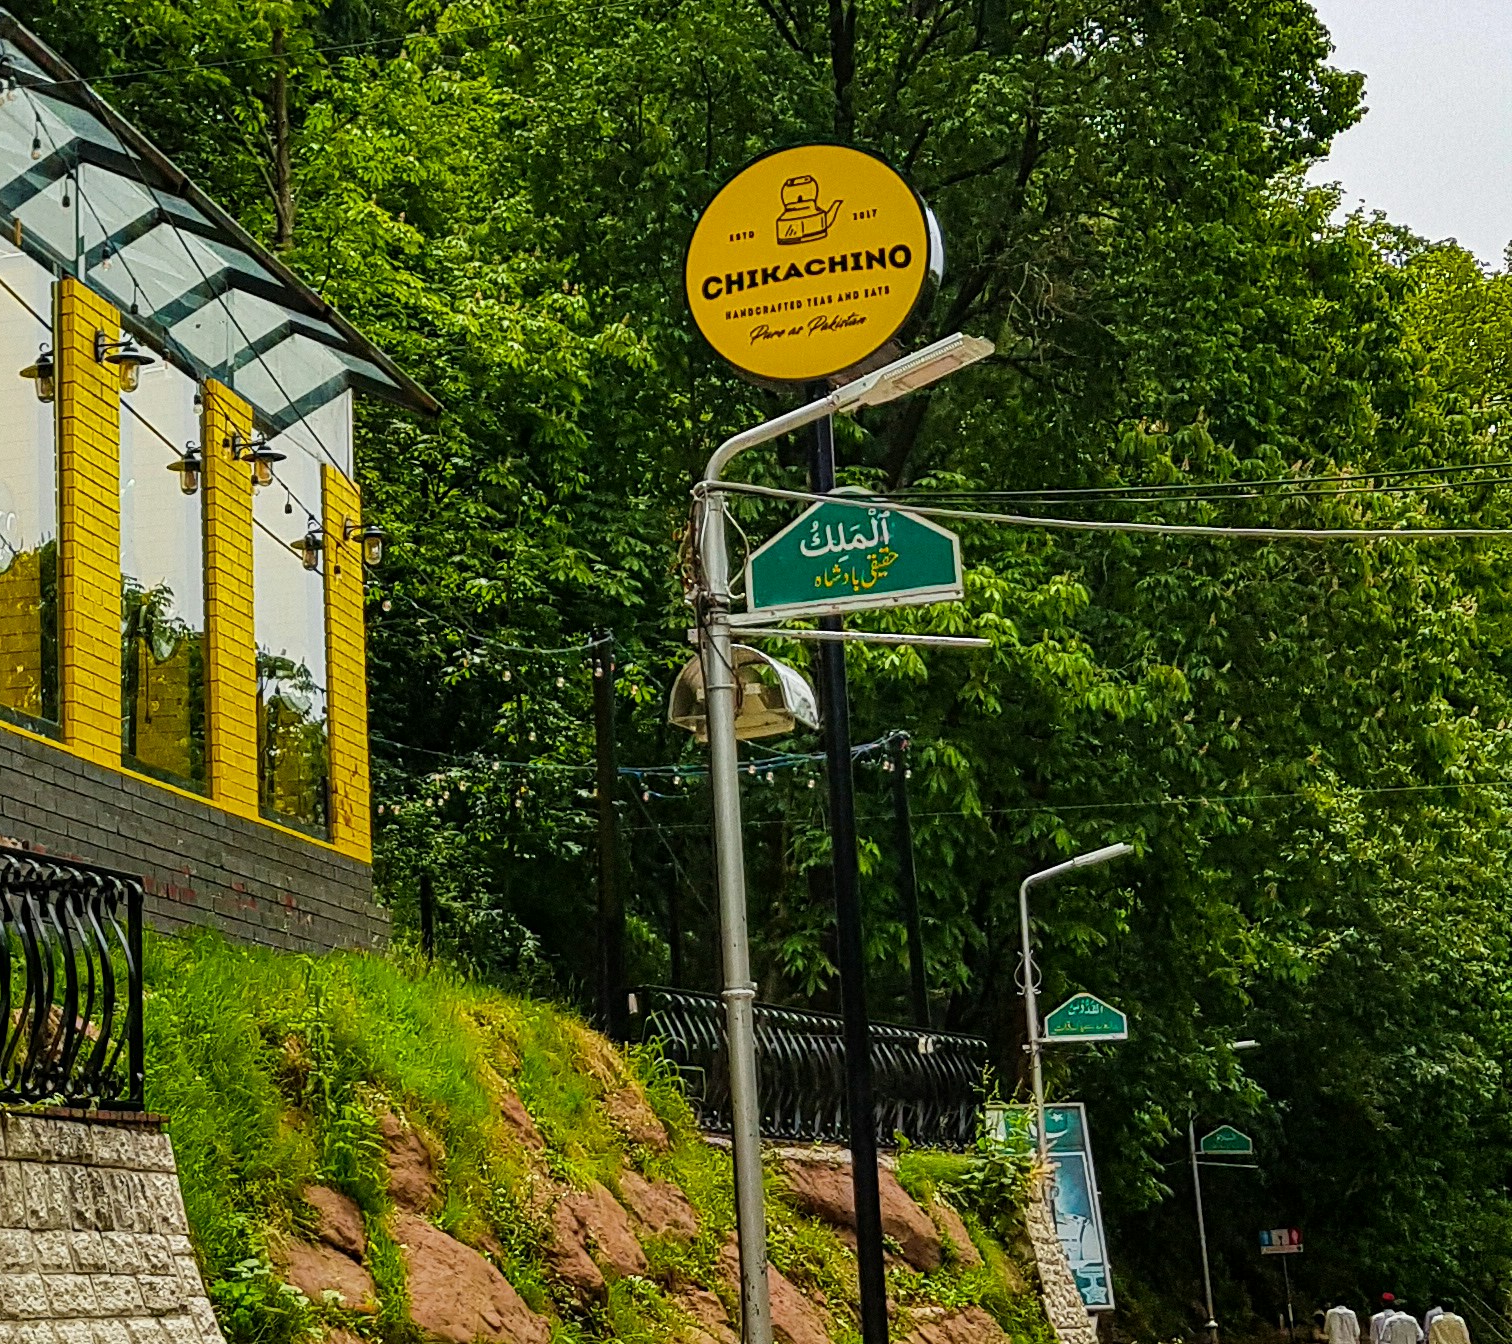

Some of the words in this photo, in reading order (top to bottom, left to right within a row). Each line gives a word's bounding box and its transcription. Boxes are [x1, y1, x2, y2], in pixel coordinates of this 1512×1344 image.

[729, 230, 755, 242] ESTD
[701, 243, 913, 300] CHIKACHINO
[725, 299, 803, 320] HANDCRAFTED
[807, 294, 833, 307] TEAS
[837, 290, 860, 303] AND
[864, 285, 890, 298] EATS
[749, 324, 786, 346] Pure
[788, 325, 804, 336] as
[807, 311, 868, 337] Pakistan
